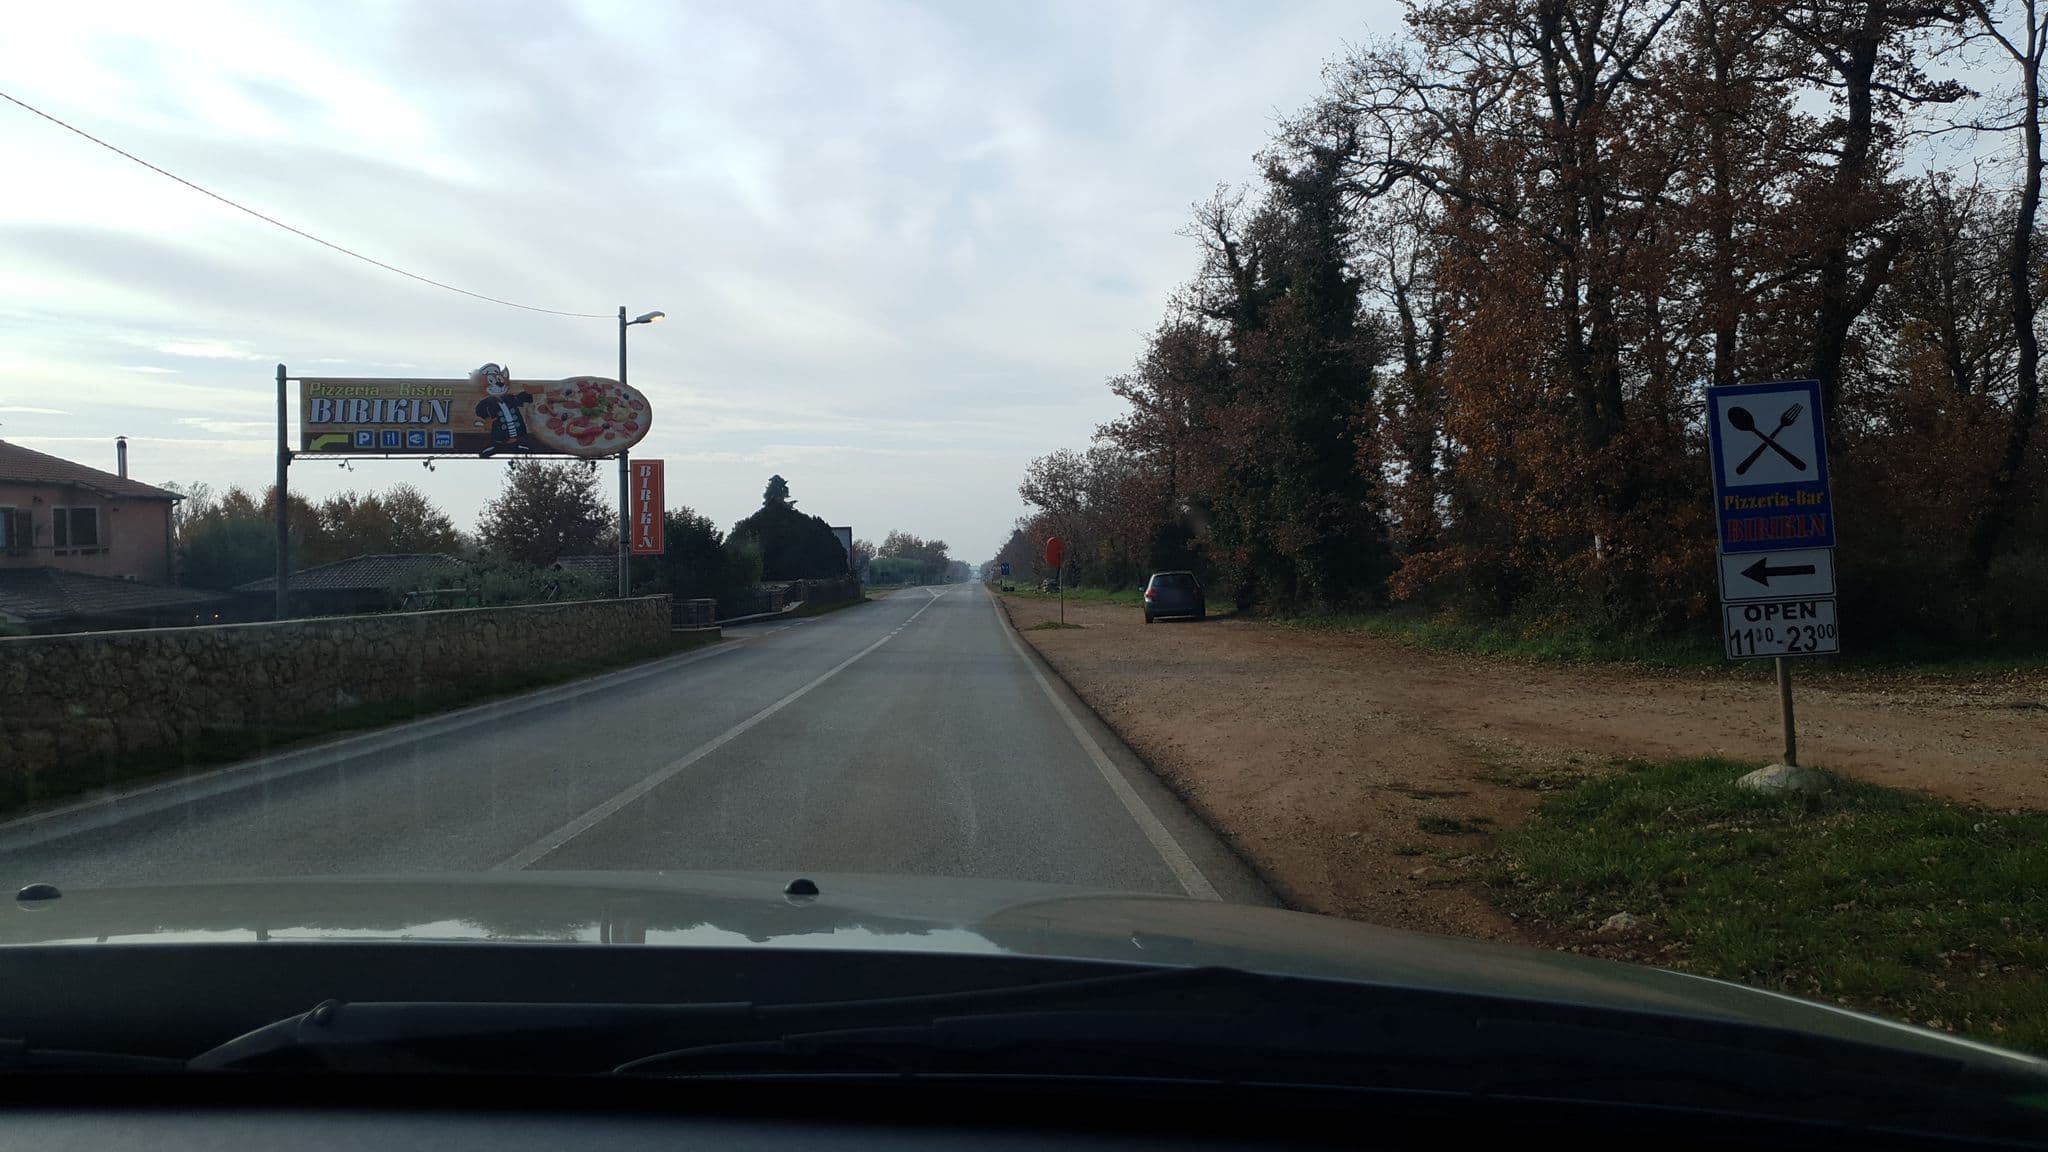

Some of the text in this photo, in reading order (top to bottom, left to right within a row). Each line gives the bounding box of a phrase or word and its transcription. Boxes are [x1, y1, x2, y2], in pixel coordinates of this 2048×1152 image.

[309, 382, 380, 397] Pizzeria
[400, 382, 453, 397] Bistro
[309, 398, 452, 424] BIRIKIN
[358, 432, 370, 445] P
[639, 465, 654, 548] BIRIKIN
[1724, 489, 1825, 511] Pizzeria-Bar
[1727, 513, 1827, 544] BIRIKIN
[1744, 602, 1817, 622] OPEN
